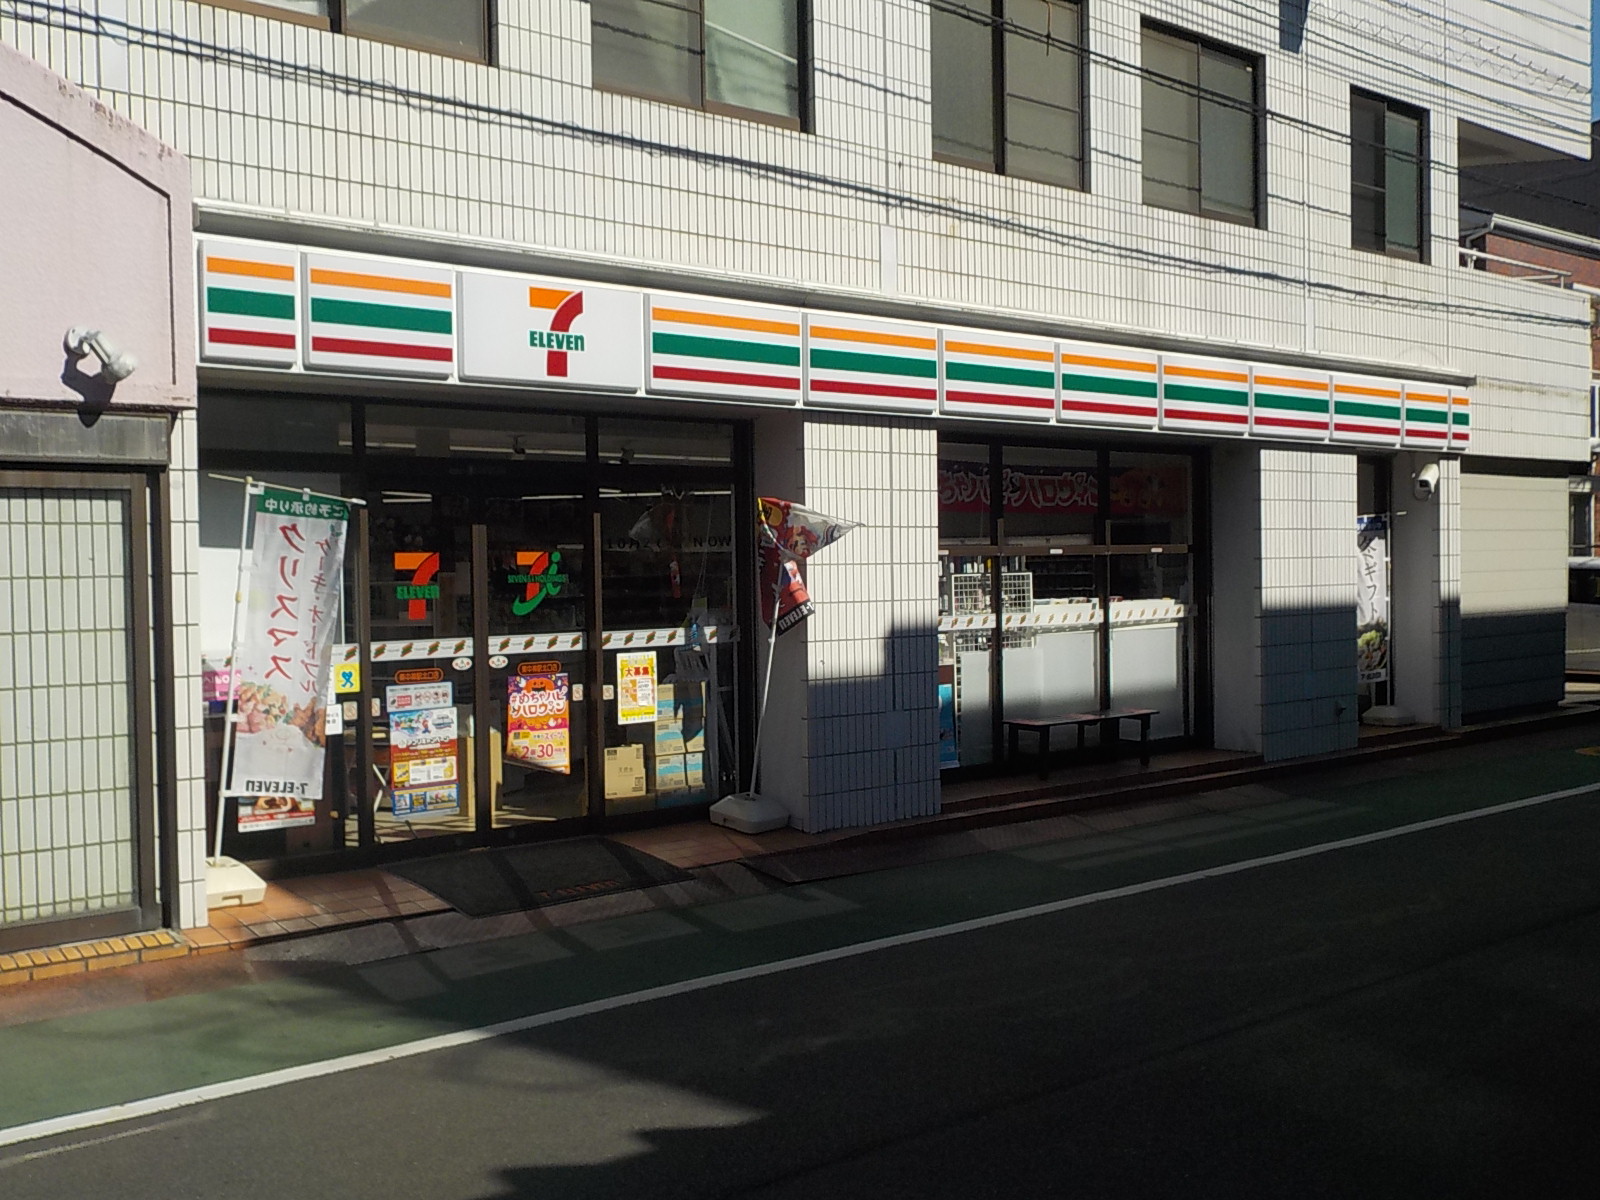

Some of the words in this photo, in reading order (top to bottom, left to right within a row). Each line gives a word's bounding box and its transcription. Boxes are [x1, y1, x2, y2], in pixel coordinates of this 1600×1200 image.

[529, 286, 584, 377] 7
[513, 702, 566, 717] ハロウィン
